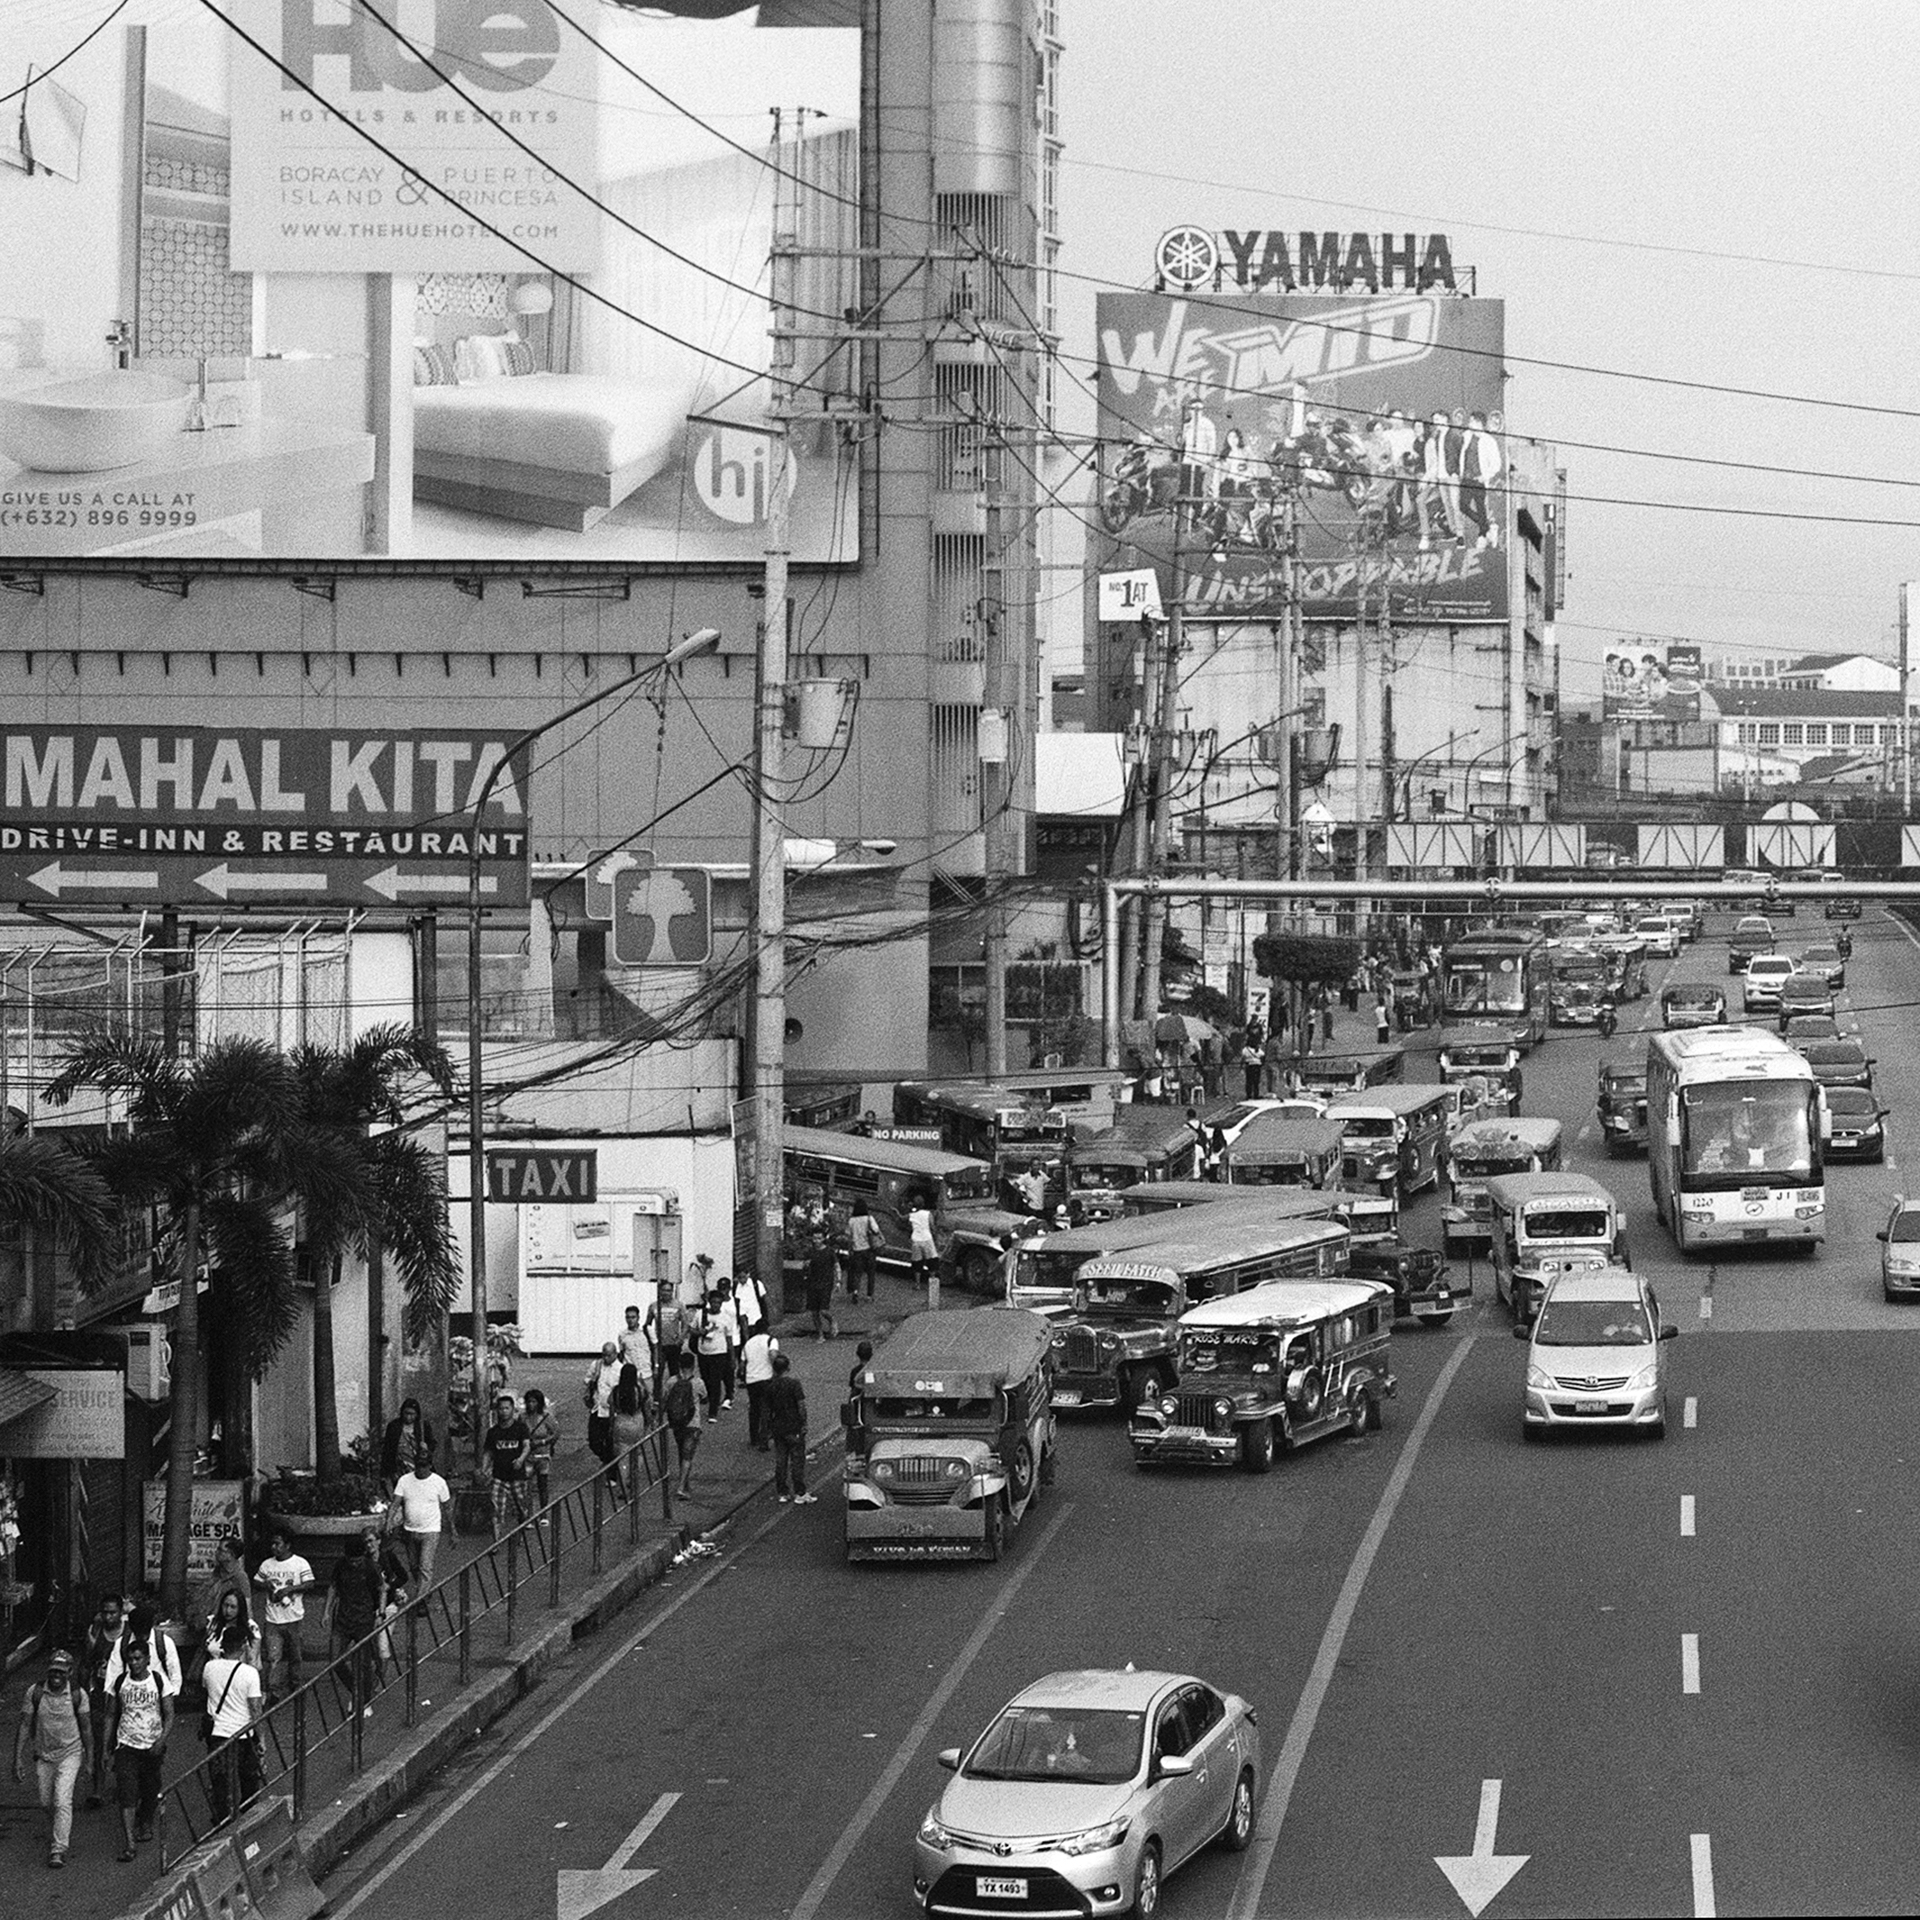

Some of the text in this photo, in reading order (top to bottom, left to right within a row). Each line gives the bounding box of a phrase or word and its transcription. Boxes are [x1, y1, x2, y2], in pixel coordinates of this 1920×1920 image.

[280, 110, 558, 123] HOTELS & RESORTS
[280, 167, 383, 182] BORACAY
[444, 167, 558, 183] PUERTO
[281, 189, 558, 205] ISLAND PRINCESA
[281, 224, 558, 238] WWW.THEHUEHOTEL.COM
[1223, 231, 1457, 290] YAMAHA
[2, 492, 196, 506] GIVE US A CALL AT
[0, 510, 197, 527] (+632) 896 9999
[1120, 579, 1135, 607] 1
[1132, 582, 1149, 602] AT
[5, 735, 523, 814] MAHAL KITA
[1, 827, 525, 857] DRIVE-INN & RESTAURANT
[873, 1129, 940, 1140] NO PARKING
[495, 1159, 588, 1196] TAXI
[215, 1524, 239, 1538] SPA
